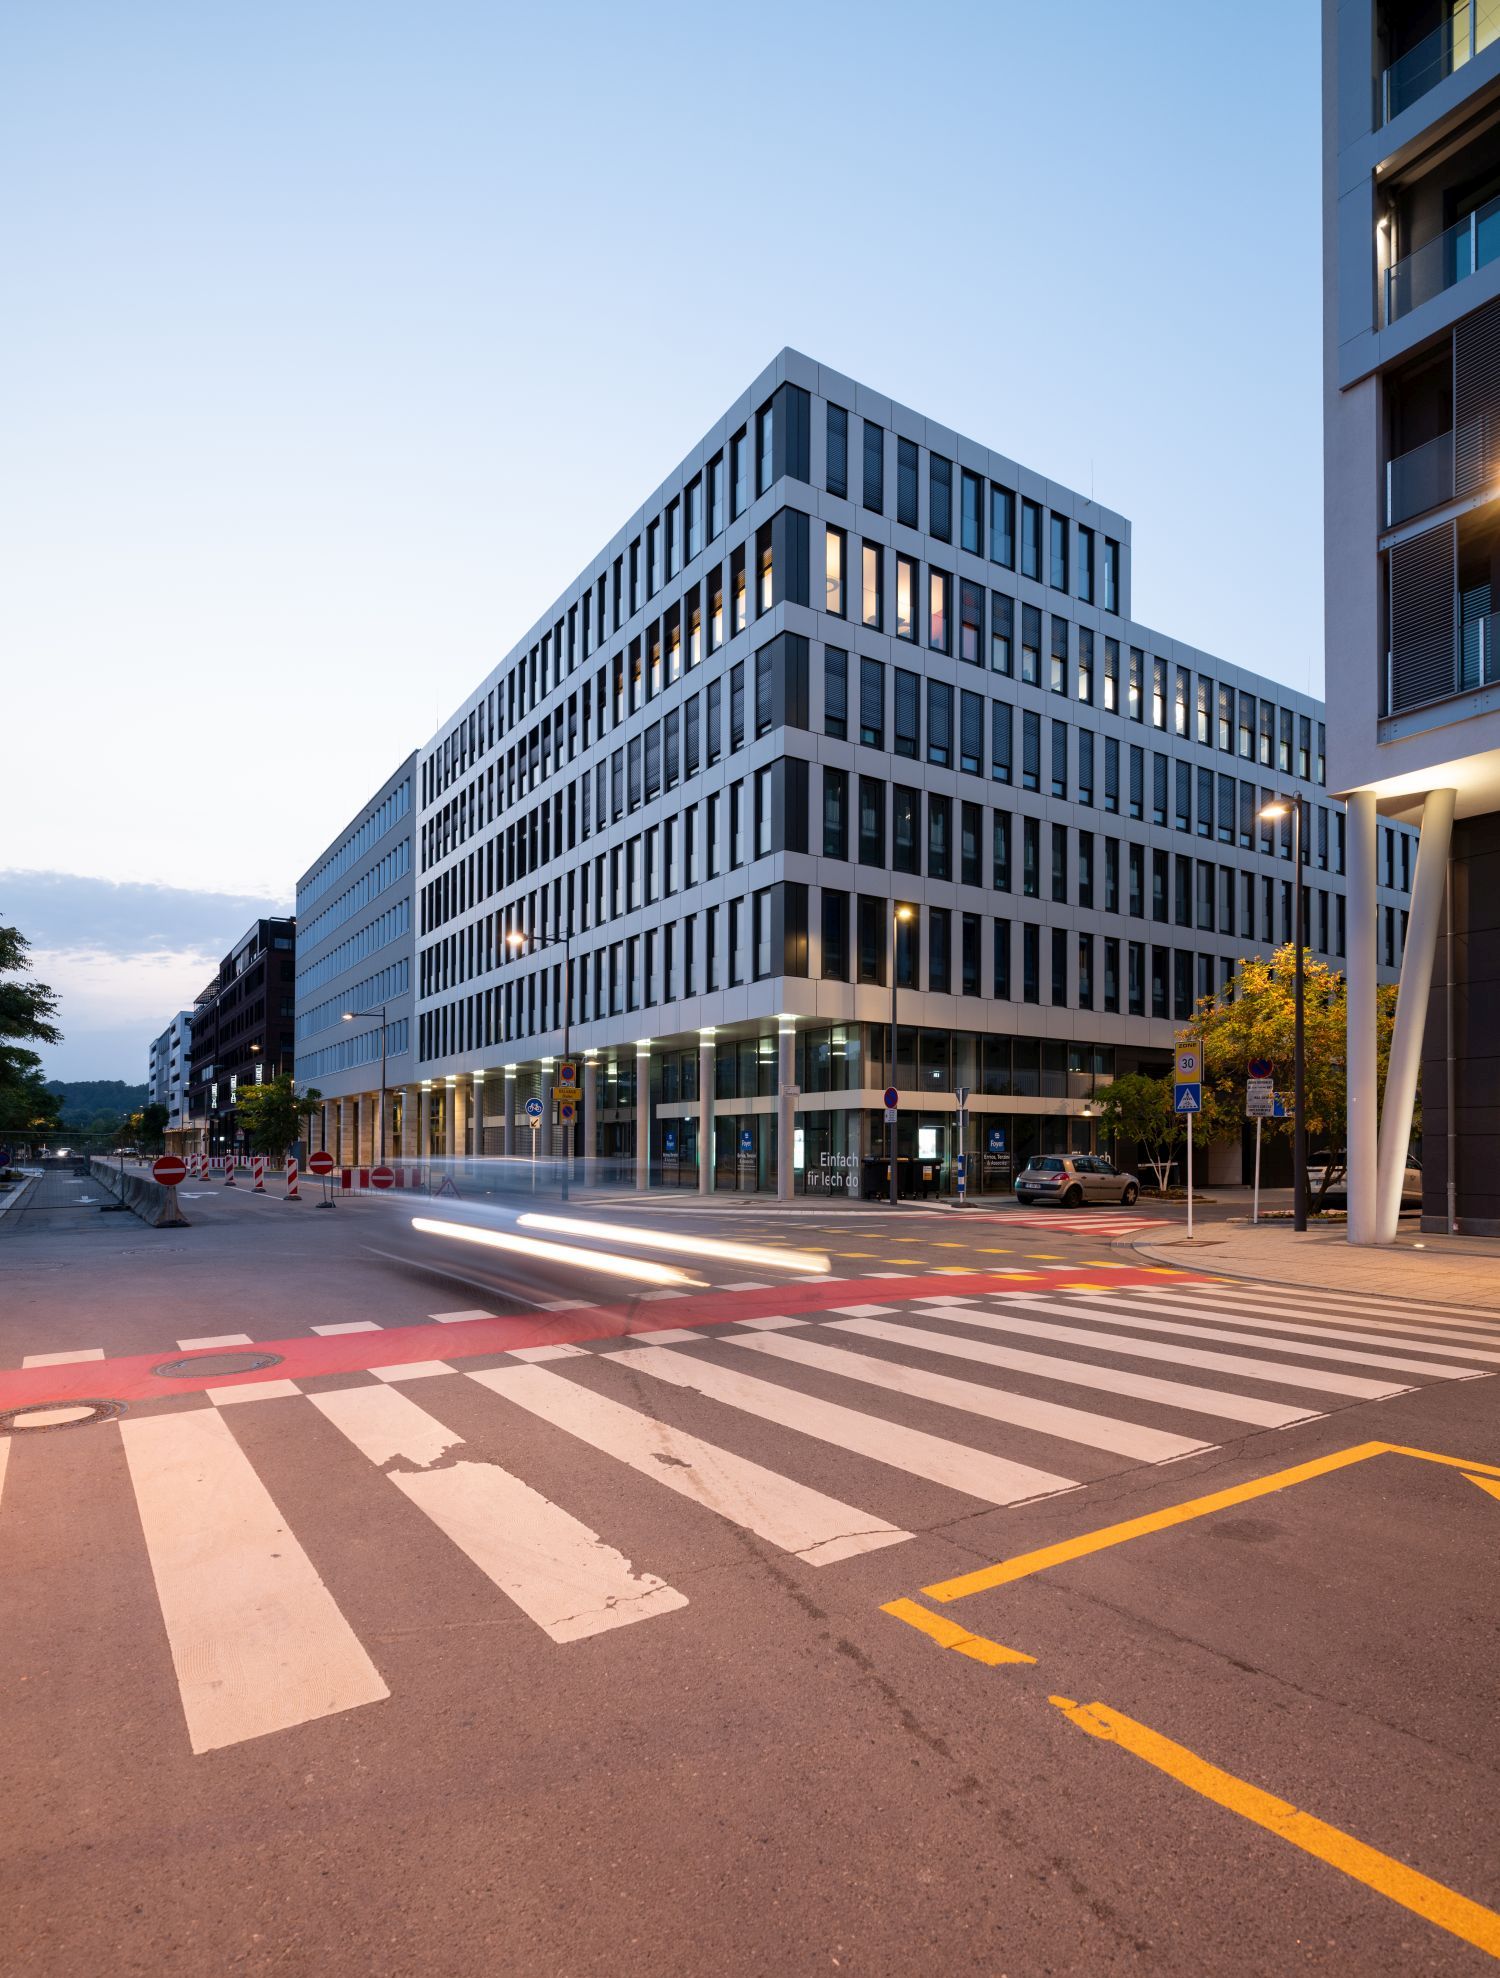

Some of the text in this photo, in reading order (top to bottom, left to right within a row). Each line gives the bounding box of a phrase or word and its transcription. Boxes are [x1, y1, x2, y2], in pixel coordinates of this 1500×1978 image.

[1182, 1058, 1194, 1069] 30
[990, 1139, 1004, 1149] Foyer
[820, 1152, 859, 1167] Einfach
[807, 1170, 859, 1187] fir lech do
